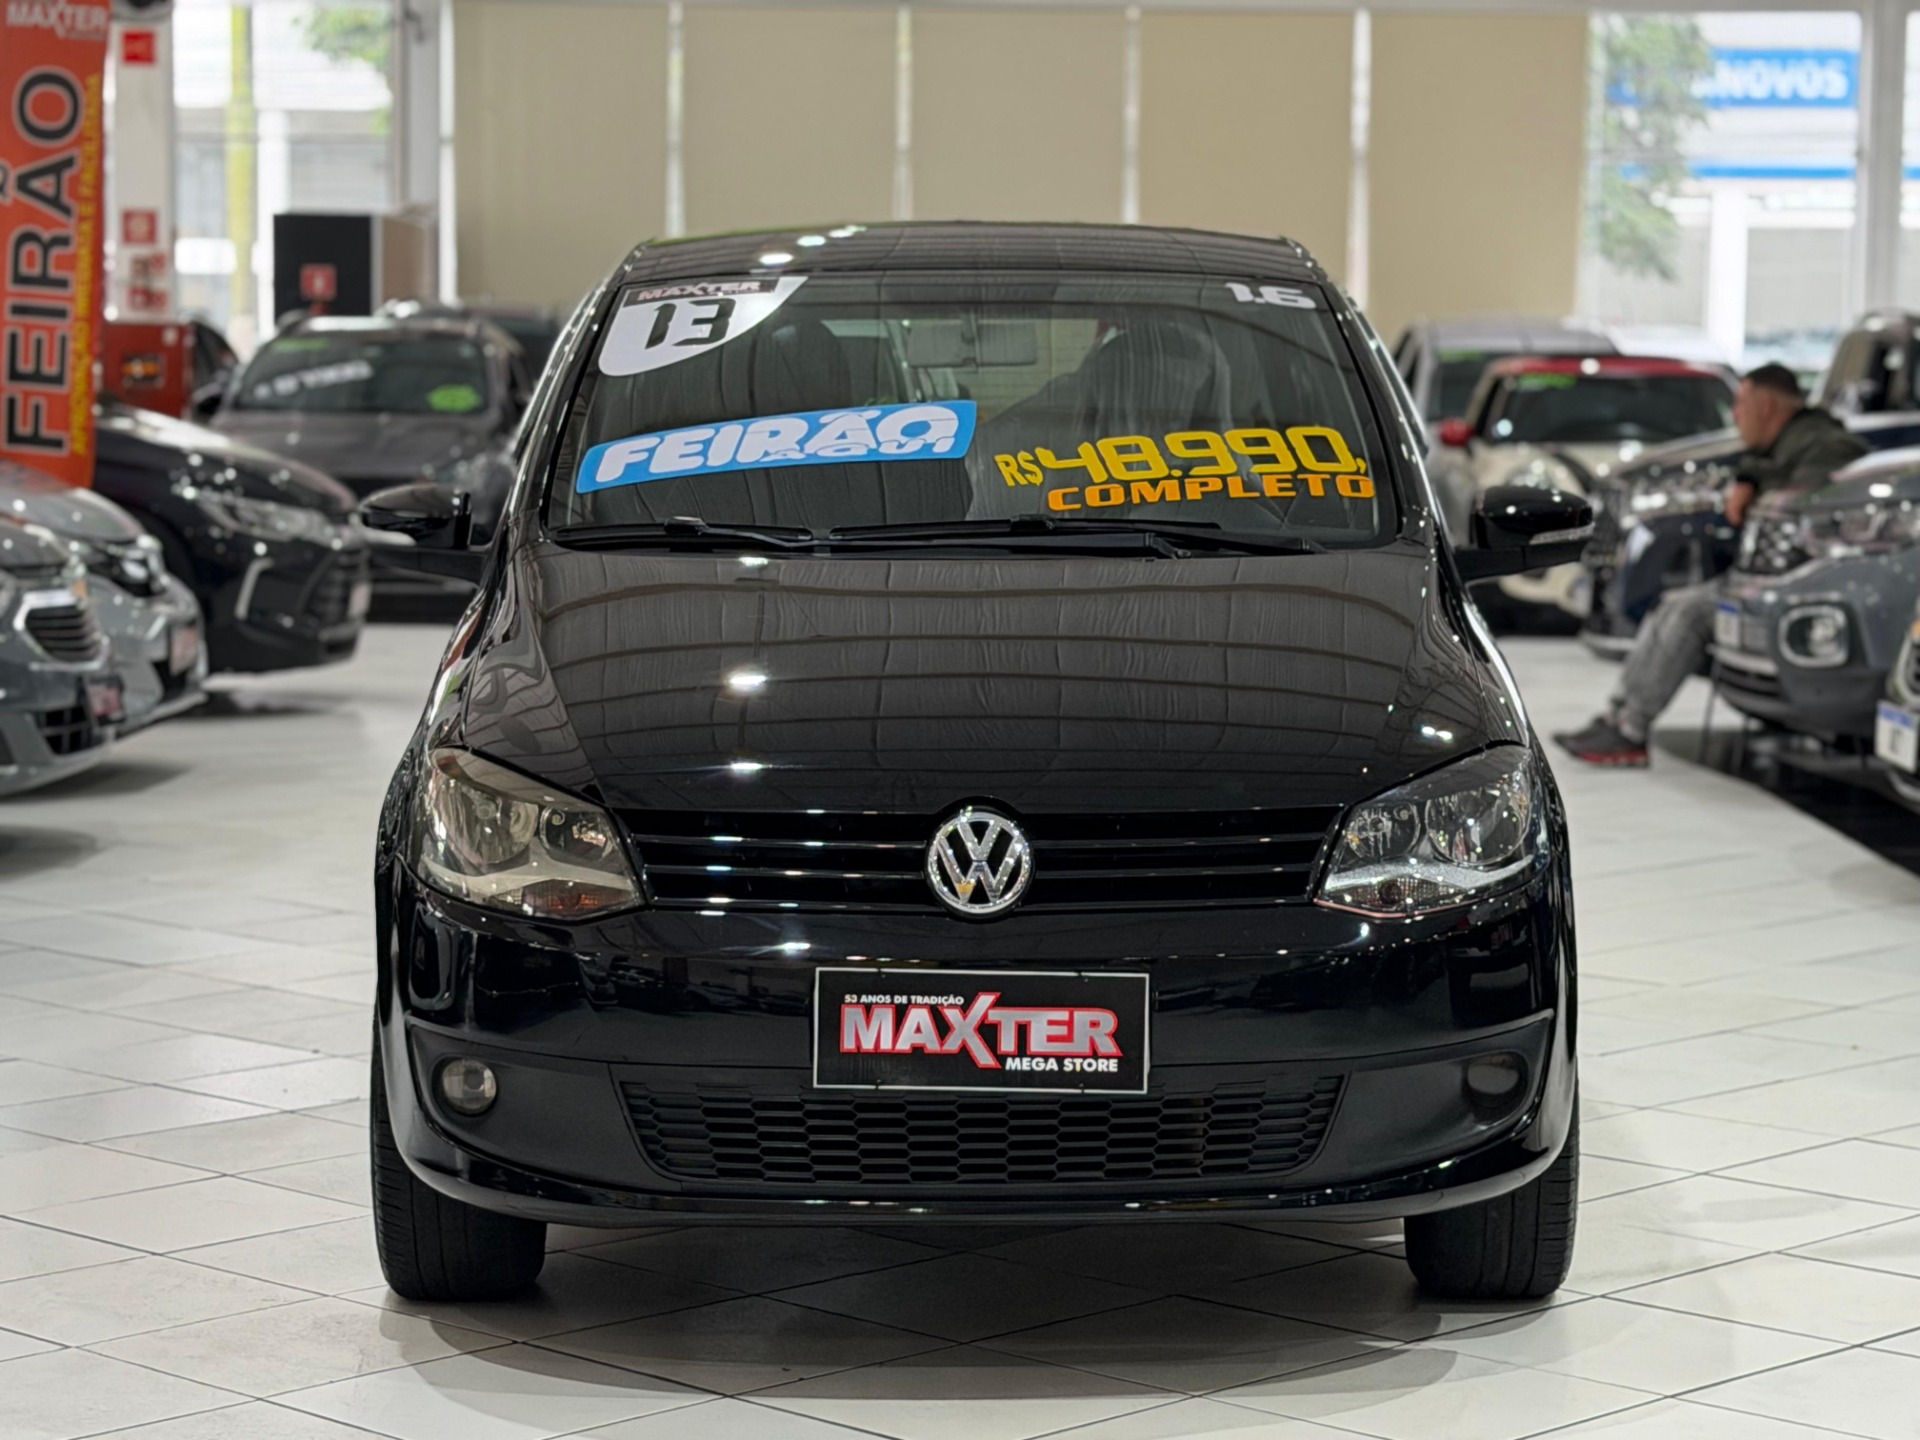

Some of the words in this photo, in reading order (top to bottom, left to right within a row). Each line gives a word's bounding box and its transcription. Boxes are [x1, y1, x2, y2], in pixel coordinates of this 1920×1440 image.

[1692, 57, 1849, 100] NOVOS
[0, 67, 83, 455] FEIRÃO
[637, 282, 761, 301] MAXTER
[1226, 282, 1316, 309] 1.6
[645, 297, 737, 351] 13
[595, 406, 960, 483] FEIRÃO
[1047, 474, 1376, 512] COMPLETO
[844, 993, 858, 1004] 53
[860, 994, 892, 1005] ANOS
[893, 995, 909, 1005] DE
[910, 993, 965, 1007] TRADIÇÃO
[839, 992, 1124, 1069] MAXTER
[1004, 1057, 1059, 1072] MEGA
[1062, 1057, 1119, 1073] STORE
